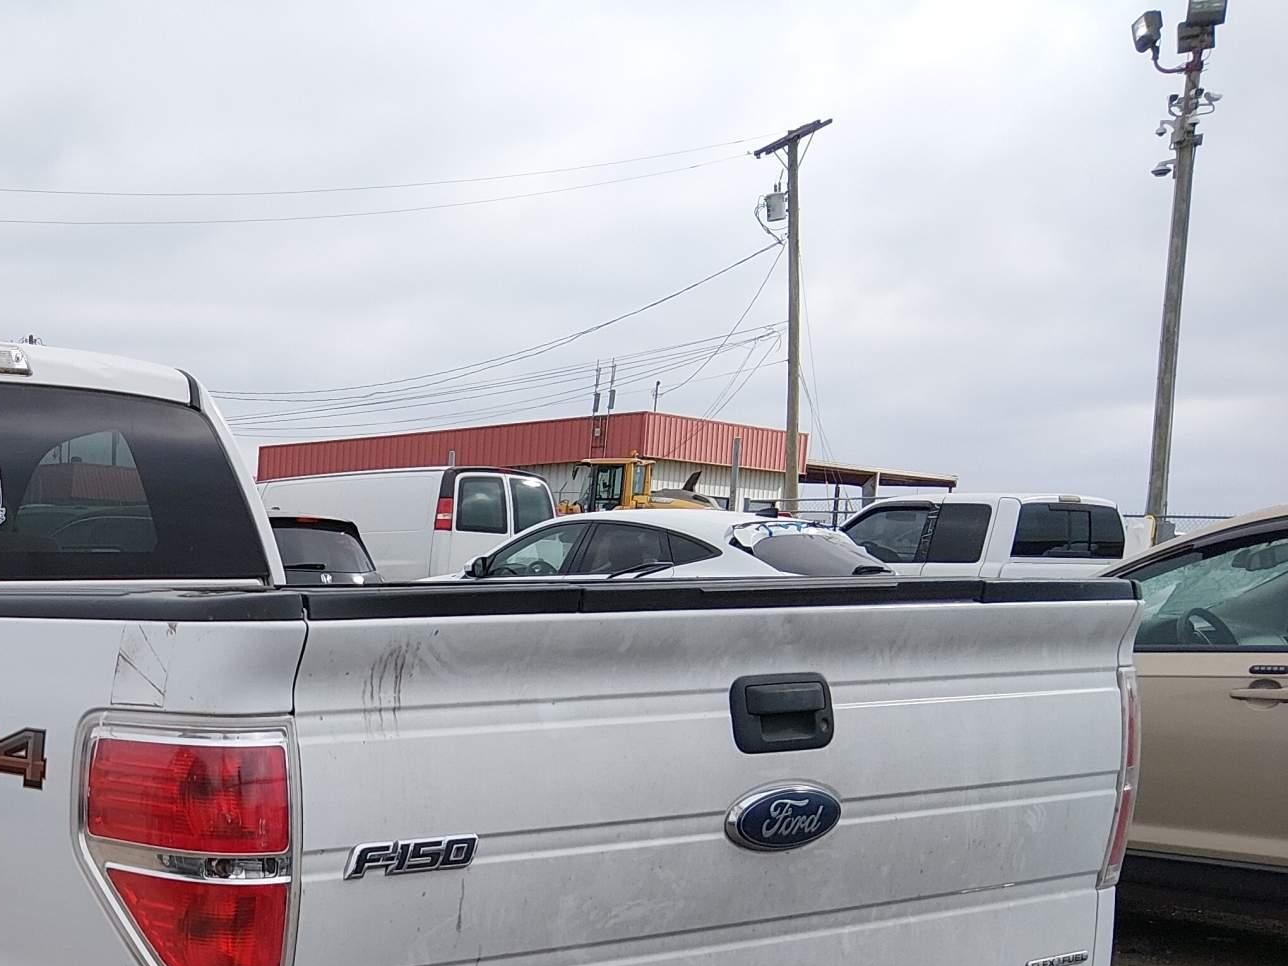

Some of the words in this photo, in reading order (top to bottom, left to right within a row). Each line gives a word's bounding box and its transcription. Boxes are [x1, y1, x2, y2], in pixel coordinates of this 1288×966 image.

[761, 798, 824, 838] Ford
[343, 833, 479, 880] F-150
[1062, 952, 1089, 965] FUEL
